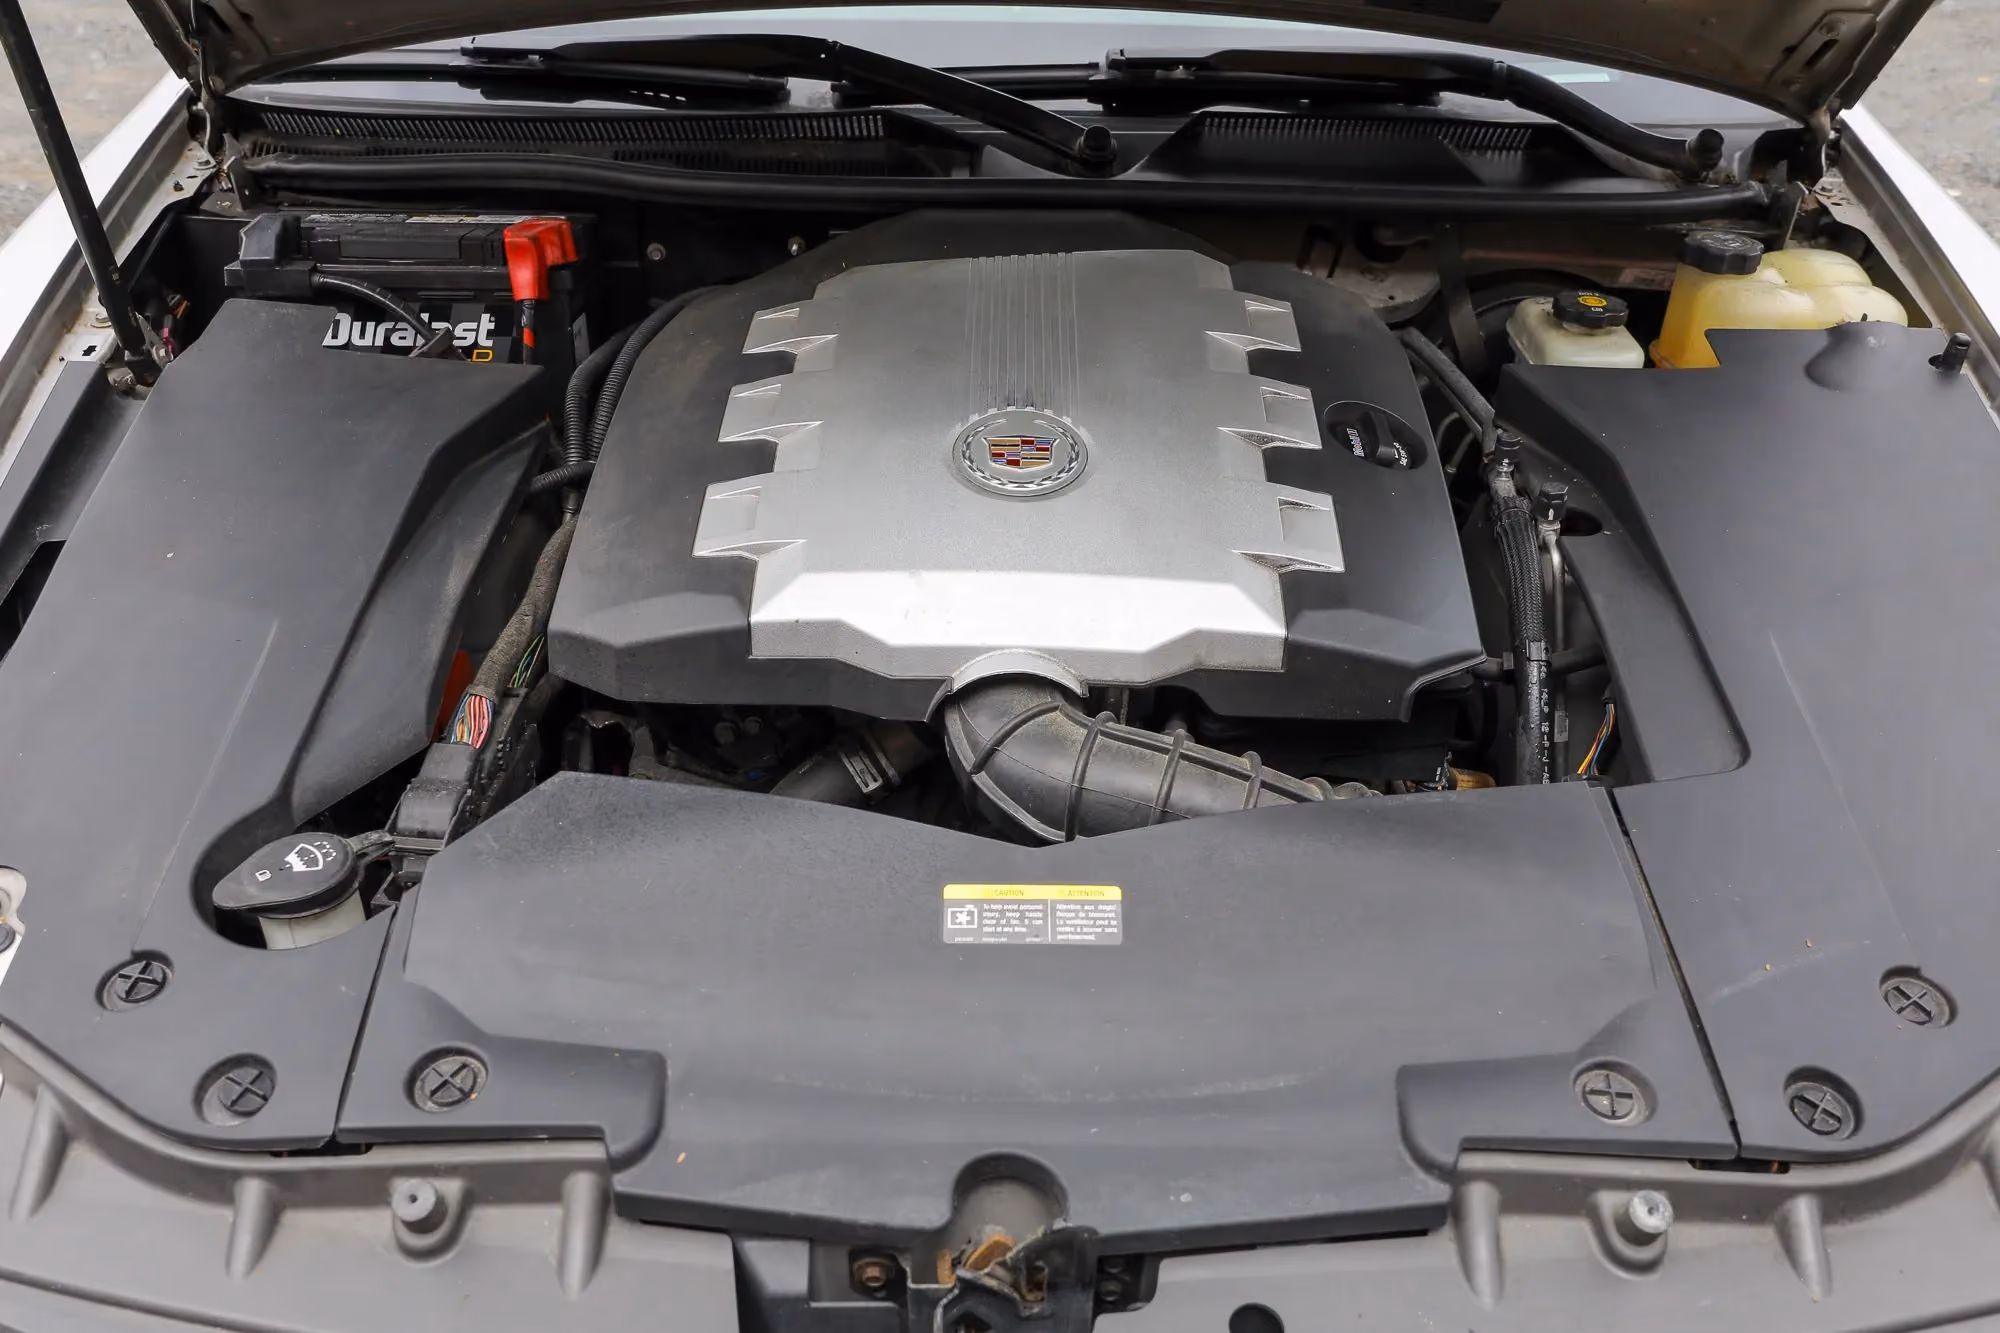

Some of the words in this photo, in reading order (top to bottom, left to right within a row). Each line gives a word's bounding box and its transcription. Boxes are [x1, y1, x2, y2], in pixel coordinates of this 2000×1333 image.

[322, 313, 495, 347] Durast
[994, 889, 1024, 897] CAUTION
[1067, 889, 1105, 897] ATTENTION
